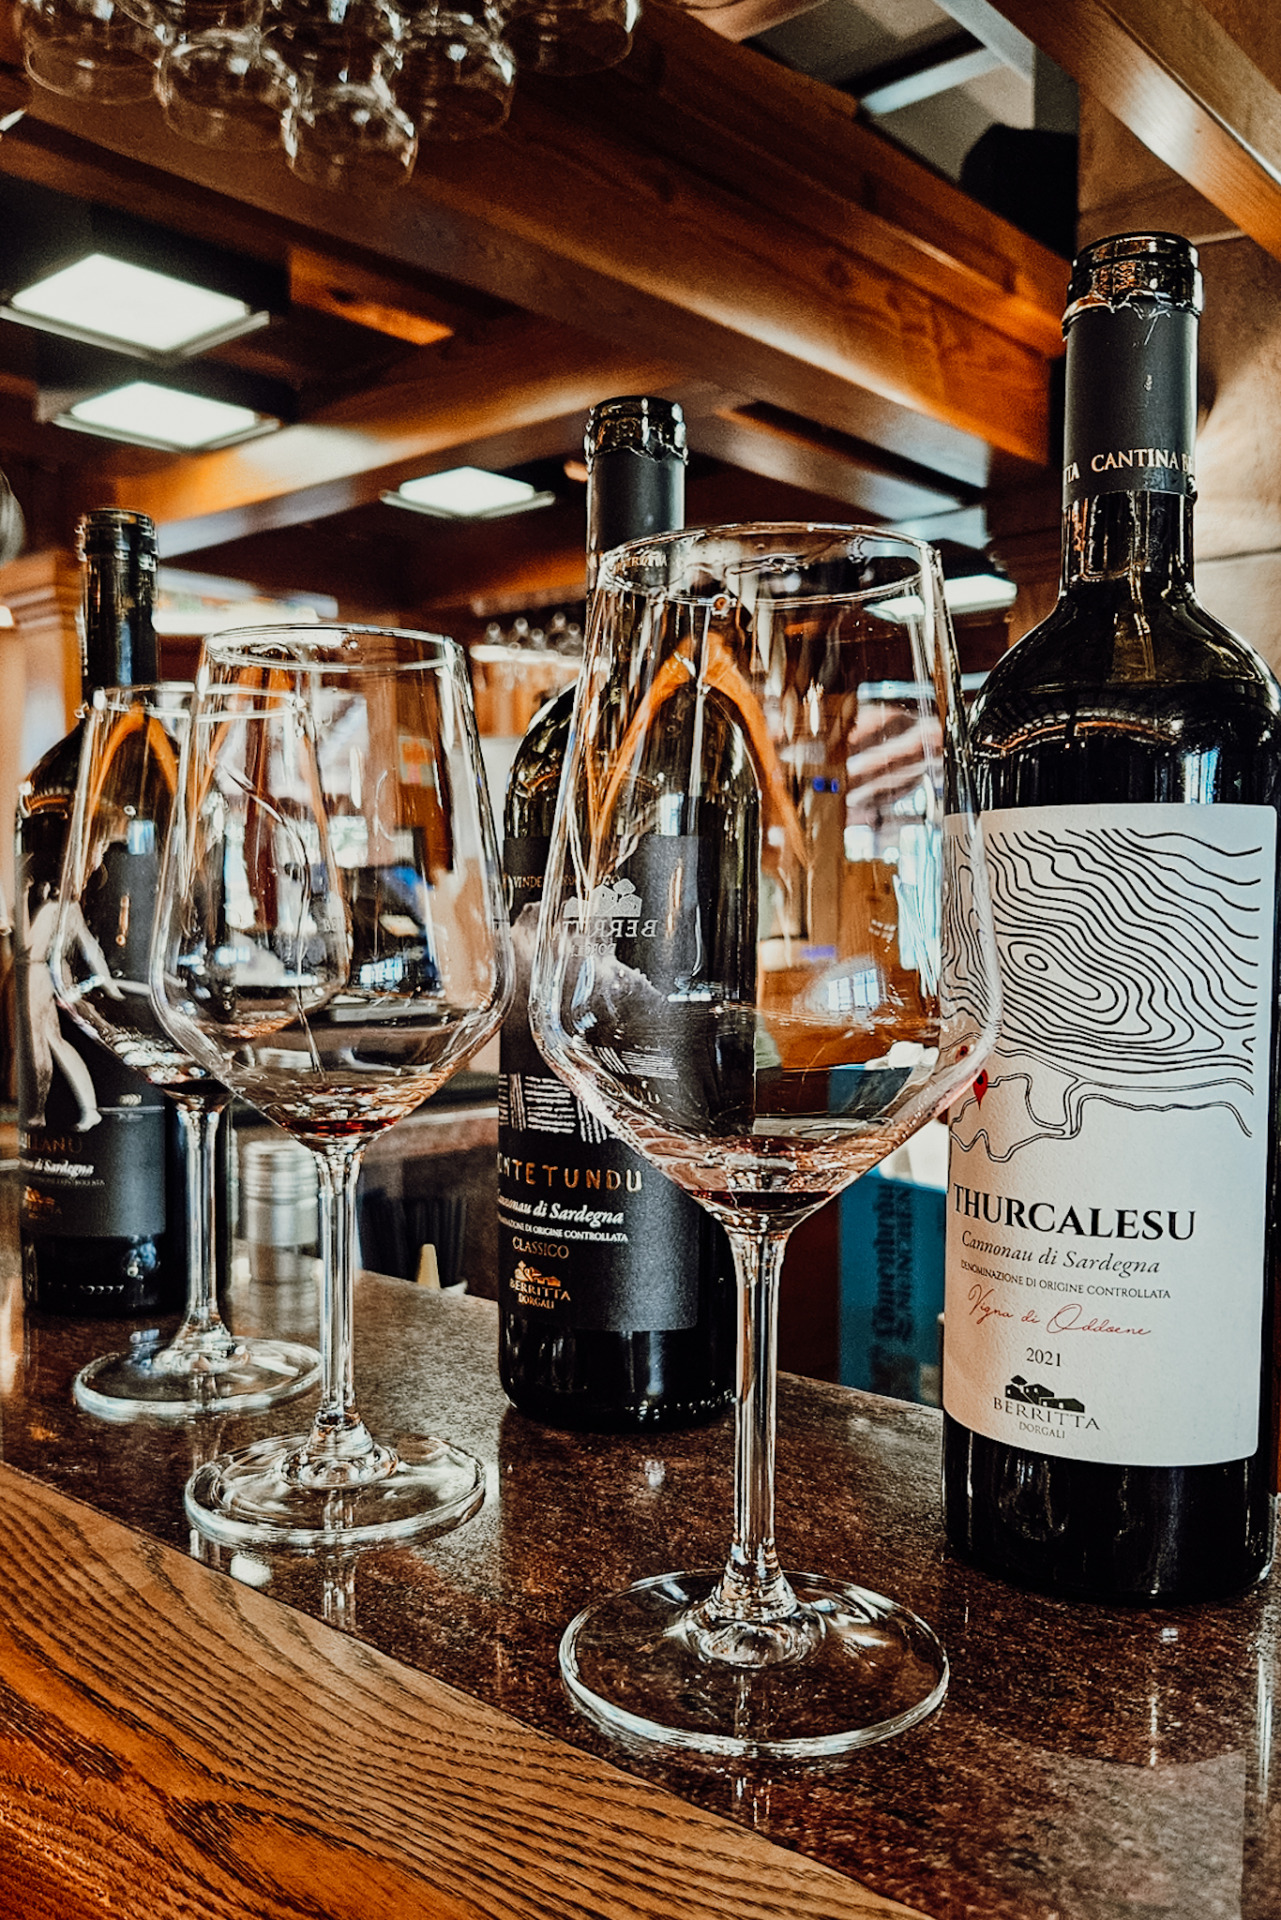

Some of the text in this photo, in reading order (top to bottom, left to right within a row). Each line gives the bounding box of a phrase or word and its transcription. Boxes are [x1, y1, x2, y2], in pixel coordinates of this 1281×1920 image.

[1091, 448, 1179, 473] CANTINA
[533, 1199, 548, 1218] di
[549, 1203, 625, 1228] Sardegna
[953, 1182, 1197, 1241] THURCALESU
[512, 1236, 570, 1260] CLASSICO
[564, 1229, 628, 1243] CONTROLLATA
[962, 1230, 1160, 1279] Cannonau di Sardegna
[509, 1277, 571, 1302] BERRITTA
[960, 1260, 1171, 1299] DENOMINAZIONE DI ORIGINE CONTROLLATA
[518, 1292, 555, 1310] DORGALI
[967, 1284, 1014, 1325] Vigna
[1020, 1309, 1041, 1325] di
[1026, 1347, 1062, 1367] 2021
[993, 1396, 1101, 1431] BERRITTA
[1019, 1421, 1066, 1439] DORGALI
